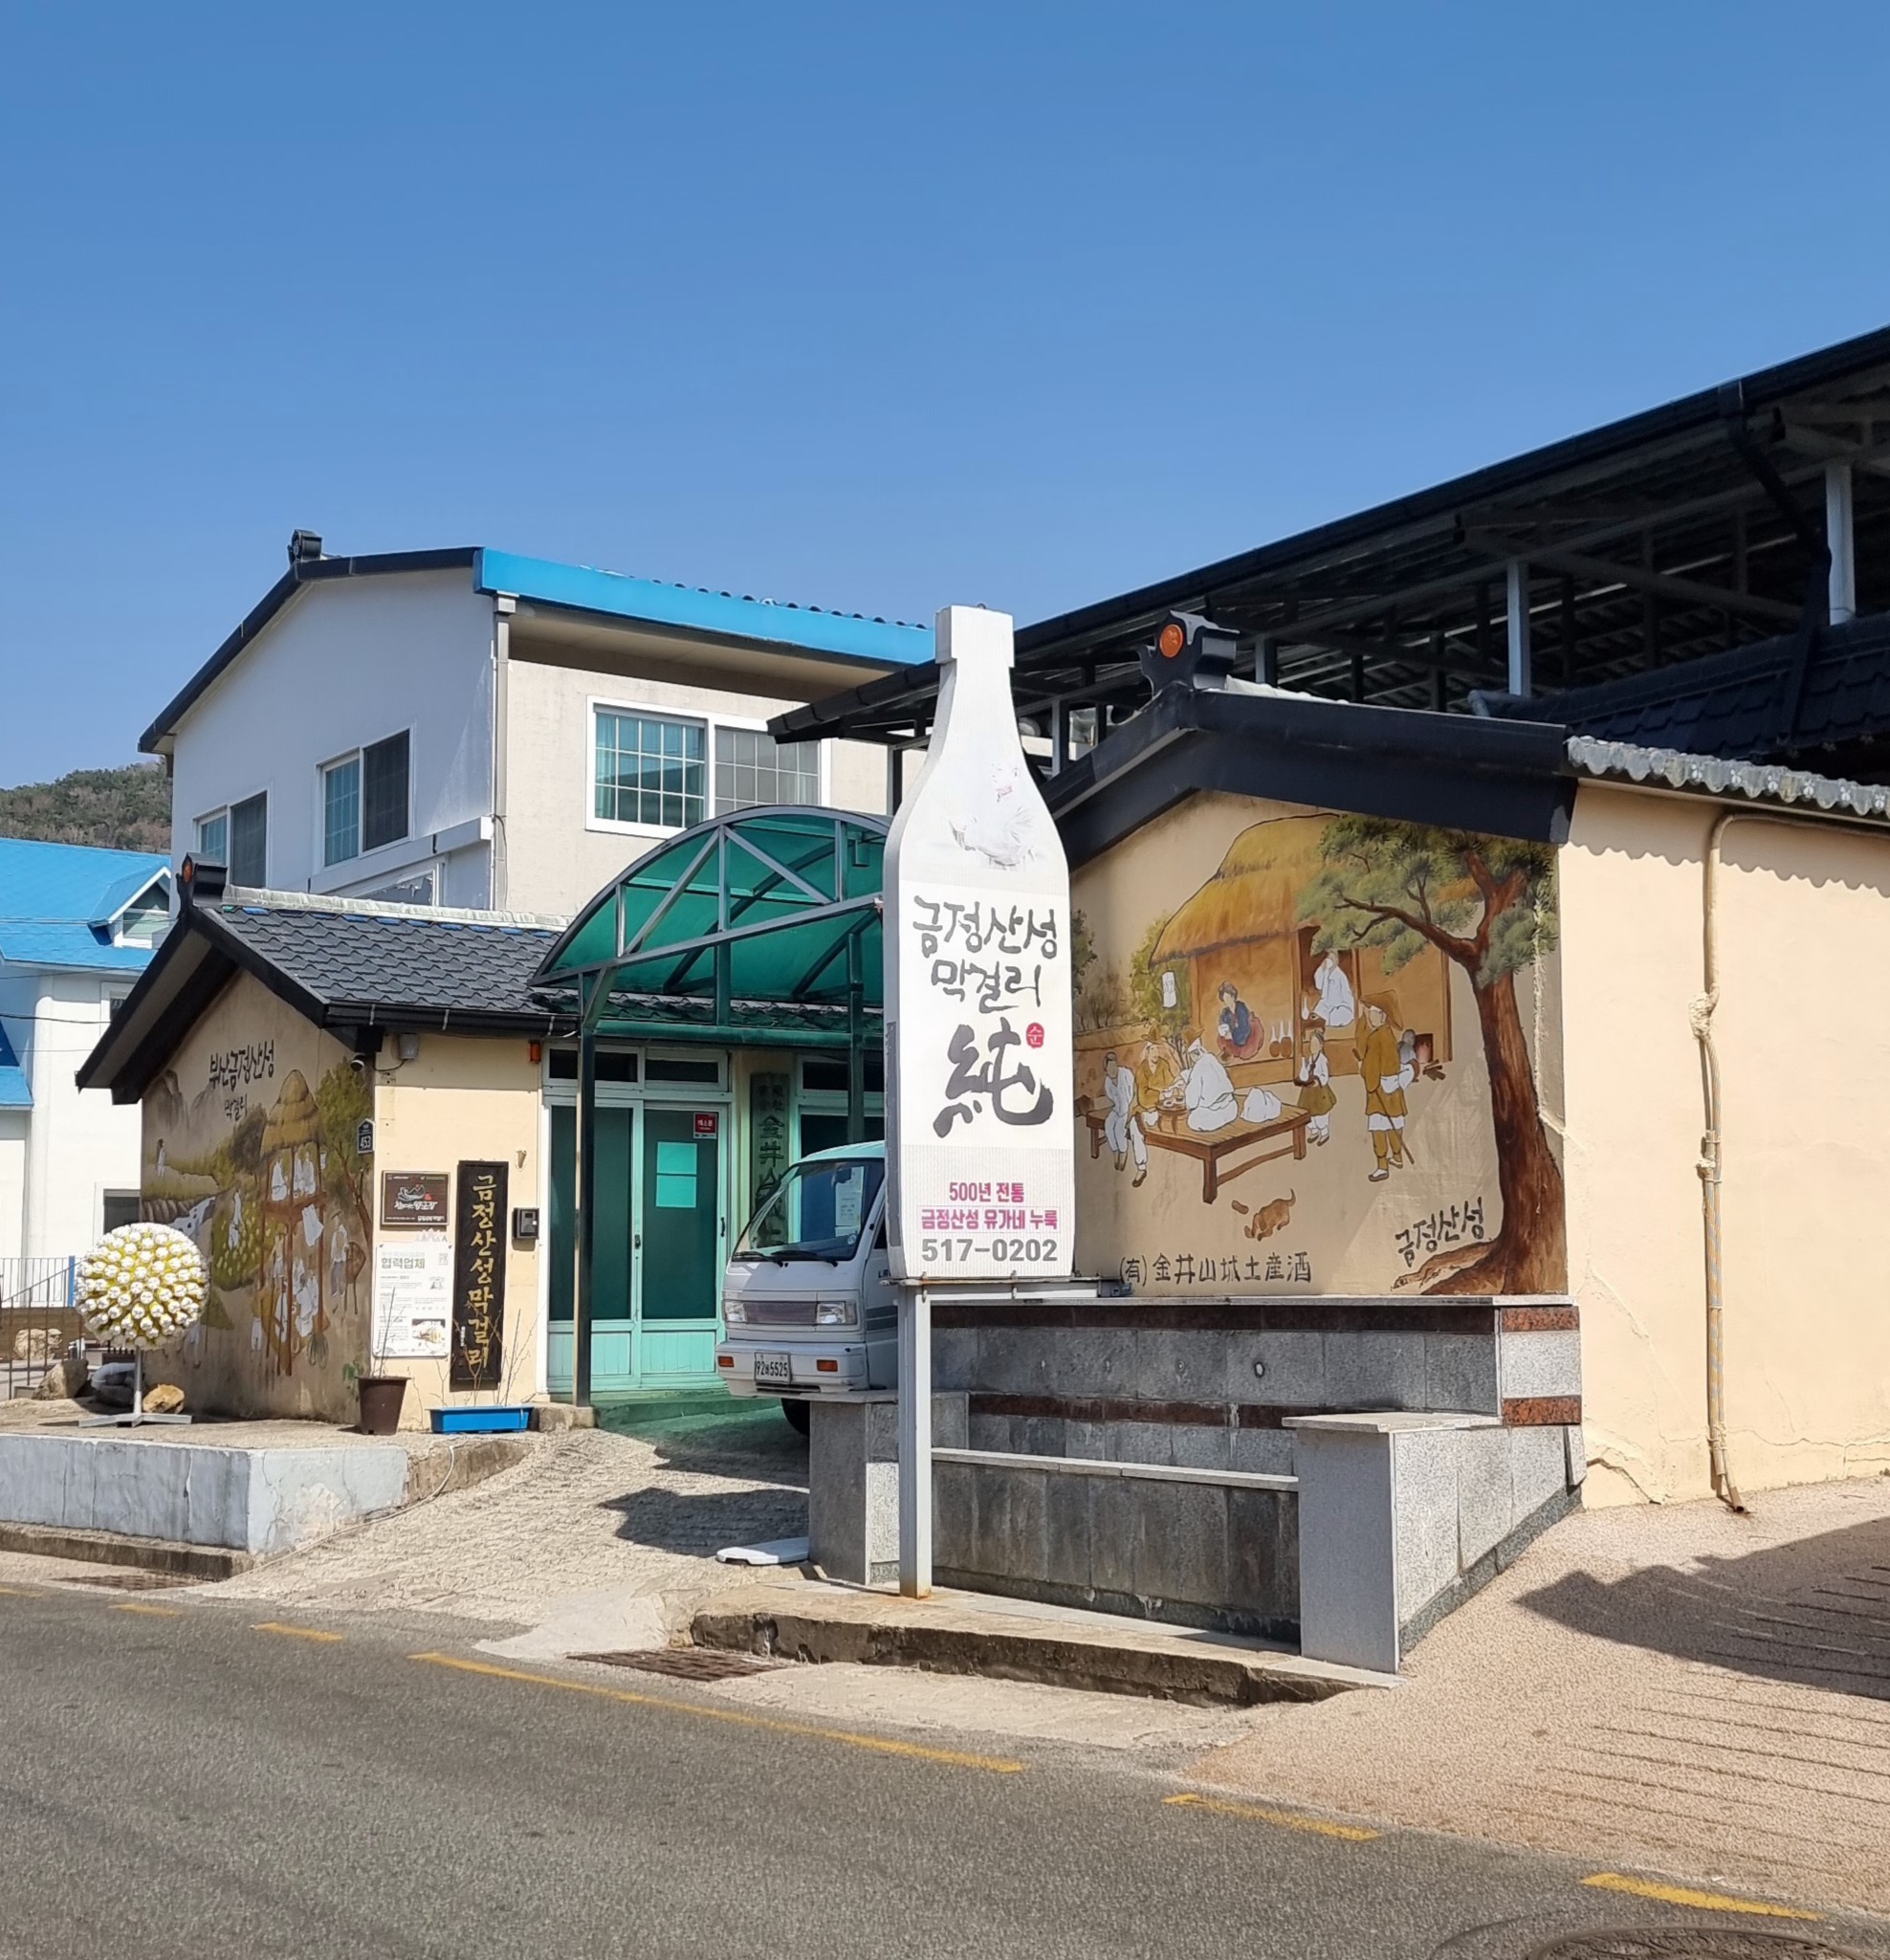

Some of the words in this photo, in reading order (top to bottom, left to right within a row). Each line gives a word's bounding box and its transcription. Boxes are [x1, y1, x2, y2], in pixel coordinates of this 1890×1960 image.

[912, 894, 1058, 959] 금정산성
[931, 958, 1042, 1014] 막걸리
[1027, 1024, 1044, 1046] 순
[933, 1016, 1054, 1138] 純
[224, 1092, 248, 1122] 막걸리
[949, 1181, 992, 1202] 500년
[996, 1182, 1024, 1203] 전통
[921, 1208, 979, 1230] 금정산성
[984, 1209, 1026, 1230] 유가네
[1029, 1209, 1058, 1230] 누룩
[1395, 1196, 1485, 1268] 금정산성
[382, 1257, 426, 1269] 협력업체
[921, 1238, 1058, 1263] 517-0202
